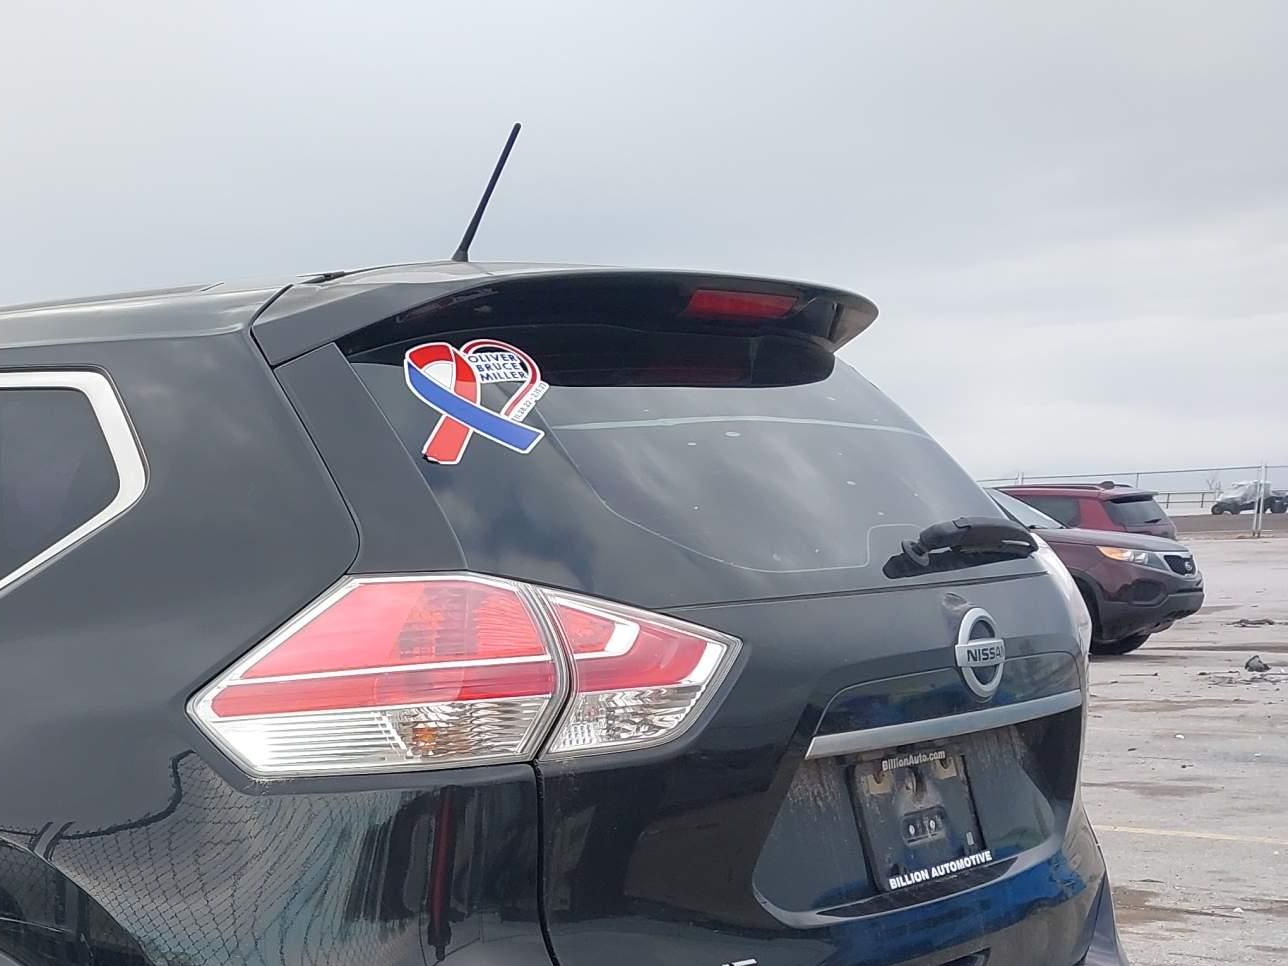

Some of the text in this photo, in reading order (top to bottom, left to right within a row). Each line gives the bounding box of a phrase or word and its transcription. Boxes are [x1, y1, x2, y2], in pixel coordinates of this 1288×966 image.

[468, 353, 517, 363] OLIVER
[476, 363, 520, 372] BRUCE
[480, 372, 527, 381] MILLER
[882, 750, 946, 771] BillionAuto.com
[889, 850, 992, 890] BILLION AUTOMOTIVE
